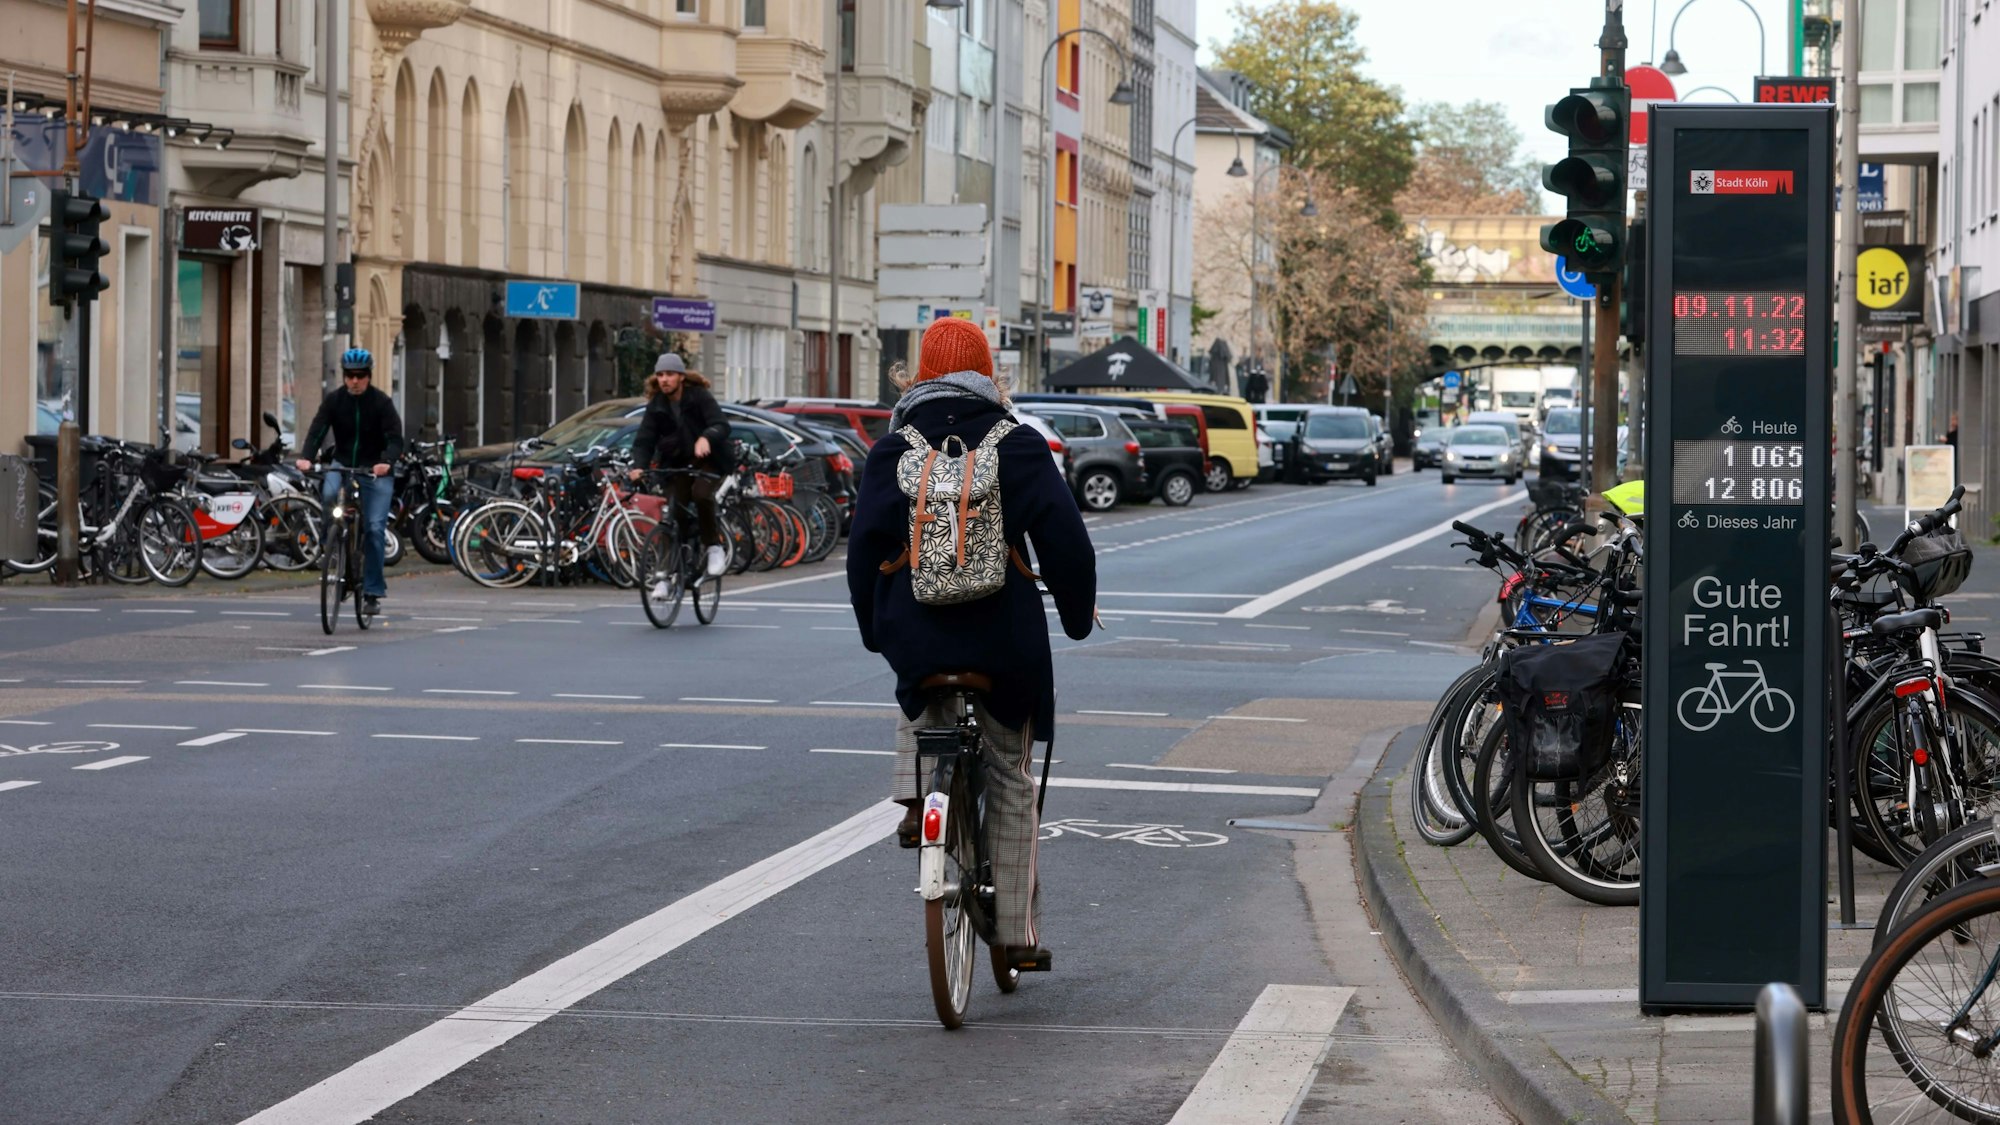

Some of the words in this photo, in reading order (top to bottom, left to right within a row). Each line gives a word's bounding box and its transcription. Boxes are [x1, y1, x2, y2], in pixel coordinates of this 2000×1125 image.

[1760, 85, 1830, 103] REWE
[1631, 176, 1646, 185] fre
[1716, 177, 1744, 188] Stadt
[1745, 177, 1769, 188] Köln
[188, 210, 252, 222] KITCHENETTE
[1869, 271, 1905, 295] iaf
[658, 305, 710, 316] Blumenhaus
[1674, 296, 1804, 318] 09.11.22
[683, 315, 710, 326] Georg
[1724, 328, 1804, 350] 11:32
[1752, 420, 1797, 435] Heute
[1723, 445, 1733, 467] 1
[1752, 445, 1802, 467] 065
[1705, 477, 1735, 499] 12
[1751, 478, 1802, 500] 806
[1706, 515, 1759, 529] Dieses
[1763, 515, 1797, 529] Jahr
[1692, 575, 1782, 609] Gute
[1683, 614, 1790, 647] Fahrt!
